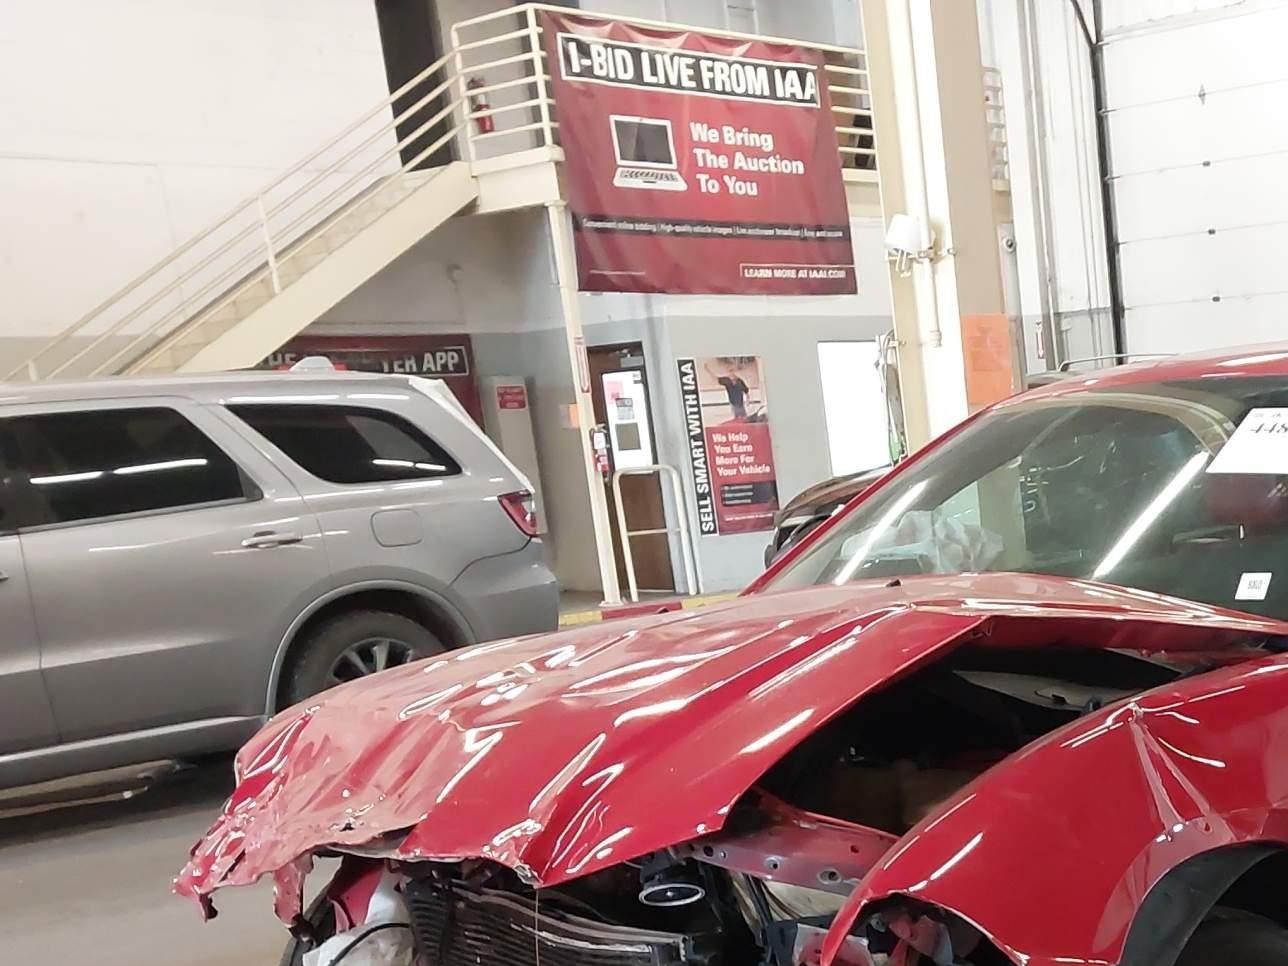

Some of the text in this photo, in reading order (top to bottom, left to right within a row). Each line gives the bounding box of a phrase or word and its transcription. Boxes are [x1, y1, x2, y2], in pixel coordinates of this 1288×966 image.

[567, 41, 817, 101] I-BID LIVE FROM IAA
[690, 121, 774, 152] We Bring
[693, 148, 805, 175] The Auction
[696, 173, 758, 196] To You
[798, 269, 808, 278] AT
[422, 352, 460, 373] APP
[680, 362, 715, 532] SELL SMART WITH IAA
[712, 432, 749, 444] We Help
[714, 445, 732, 454] You
[717, 467, 737, 477] Your
